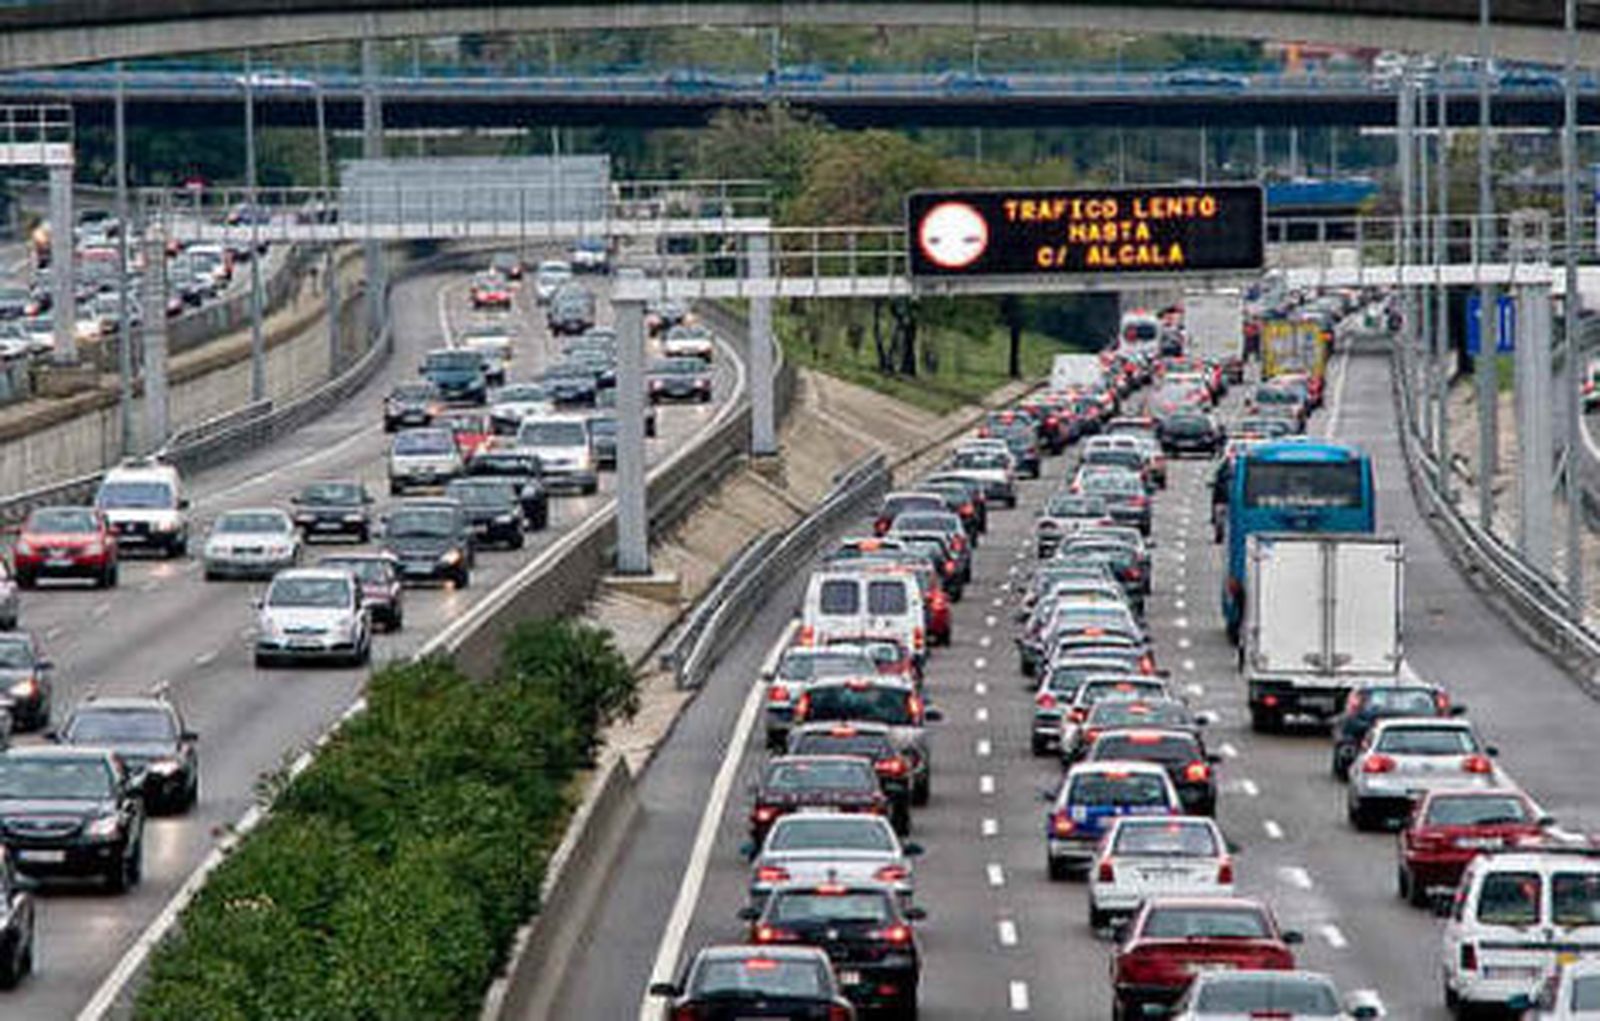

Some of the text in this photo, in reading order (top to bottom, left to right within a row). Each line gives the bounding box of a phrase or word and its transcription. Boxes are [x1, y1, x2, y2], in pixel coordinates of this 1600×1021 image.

[1003, 195, 1216, 220] TRAFICO LENTO
[1068, 221, 1150, 241] HASTA
[1036, 243, 1183, 266] C/ ALCALA
